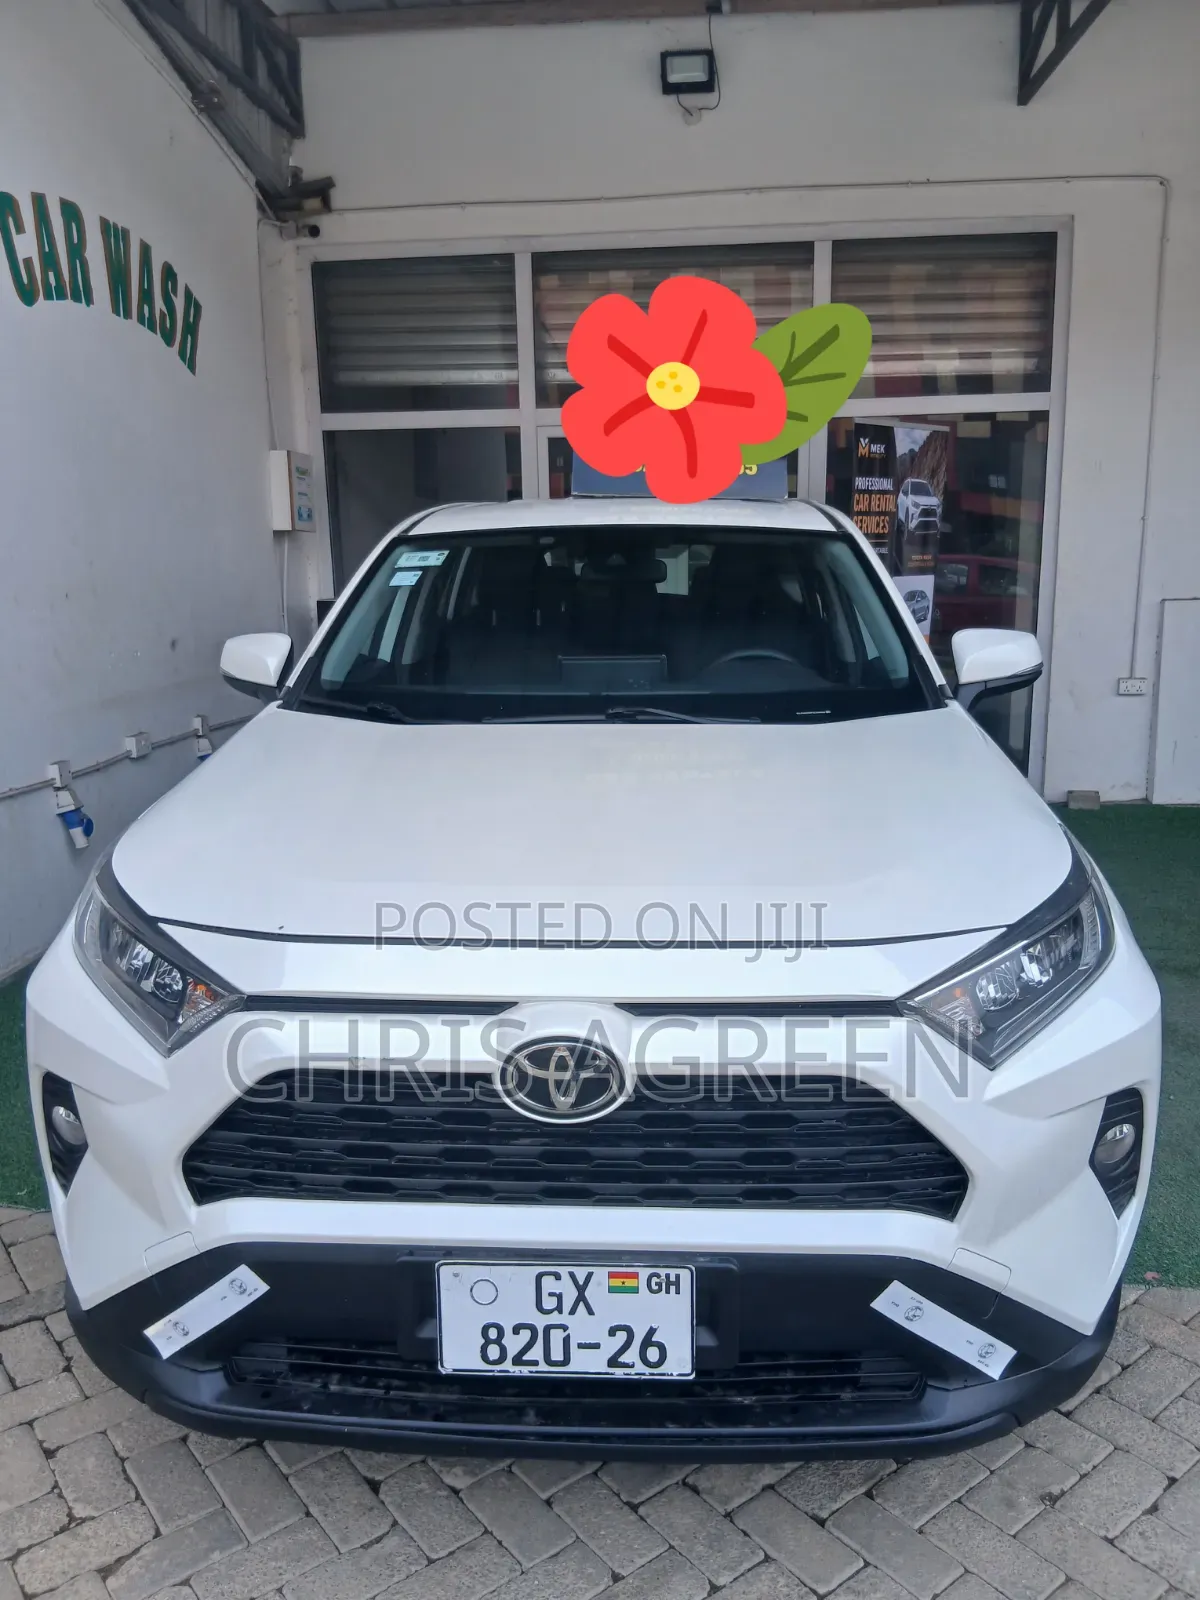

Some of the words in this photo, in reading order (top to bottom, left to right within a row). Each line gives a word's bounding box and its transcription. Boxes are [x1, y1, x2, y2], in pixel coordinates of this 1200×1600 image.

[0, 191, 94, 307] CAR
[99, 215, 202, 376] WASH
[870, 443, 886, 453] MEK
[855, 476, 893, 490] PROFESSIONAL
[853, 494, 869, 512] CAR
[871, 494, 896, 512] RENTAL
[534, 1270, 595, 1316] GX
[646, 1271, 681, 1295] GH
[479, 1321, 668, 1369] 820-26
